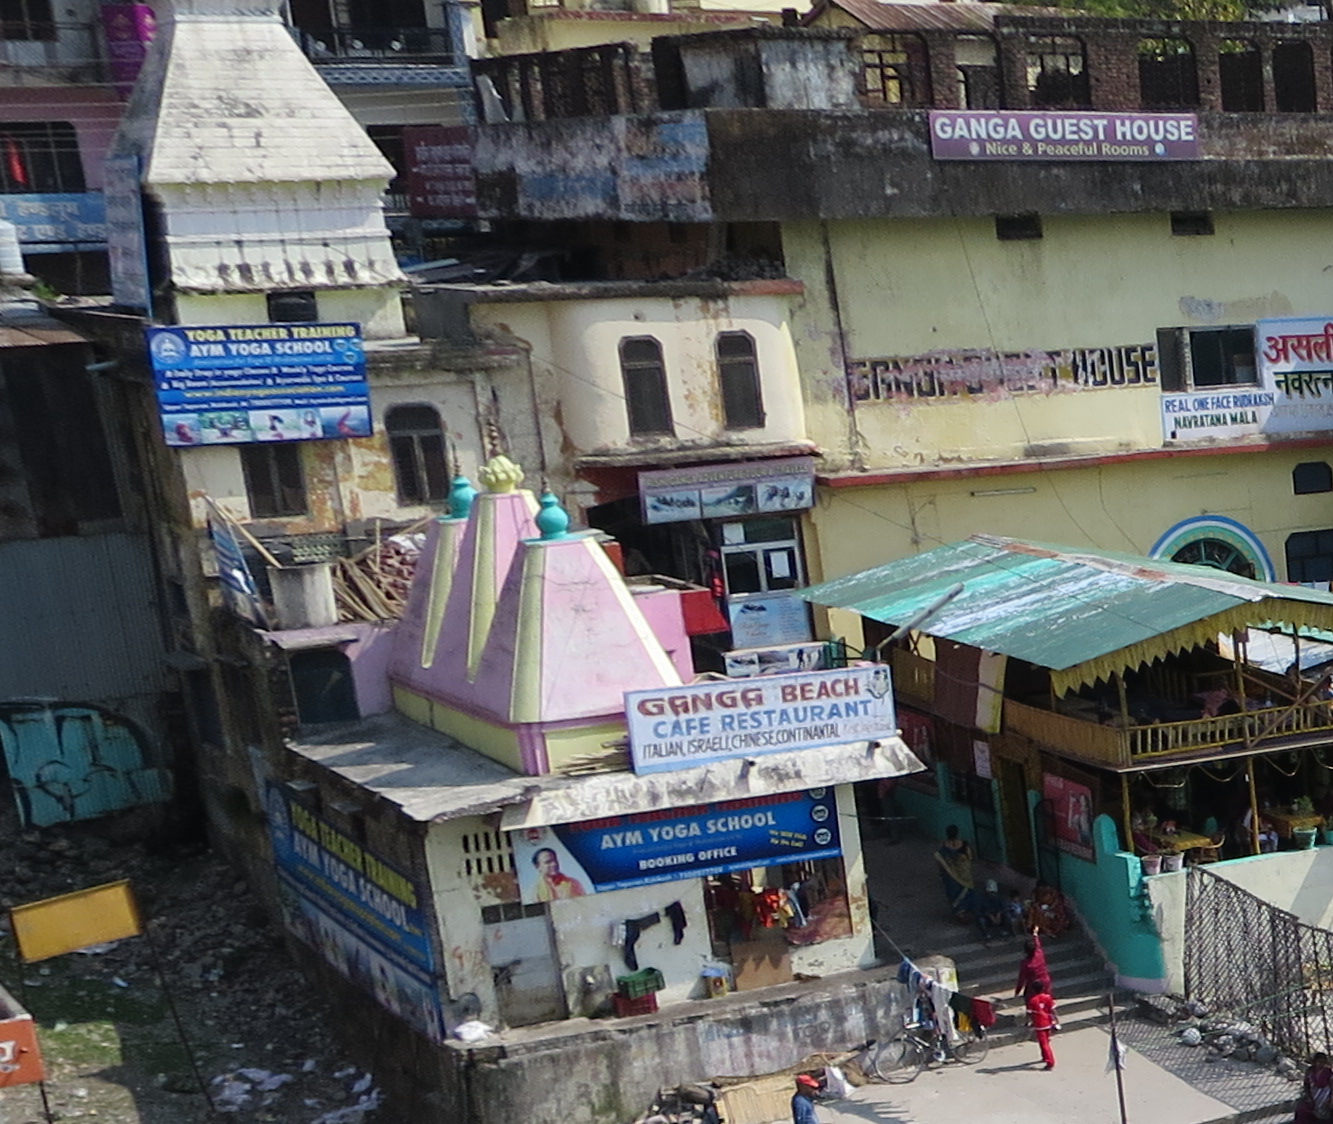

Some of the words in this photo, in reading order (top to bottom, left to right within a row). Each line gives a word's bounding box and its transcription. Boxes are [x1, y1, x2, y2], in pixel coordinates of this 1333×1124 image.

[934, 116, 1024, 141] GANGA
[1028, 117, 1109, 141] GUEST
[1114, 118, 1195, 142] HOUSE
[985, 142, 1018, 156] Nice
[1022, 142, 1034, 156] &
[1037, 142, 1098, 156] Peaceful
[1101, 142, 1149, 156] Rooms
[184, 329, 226, 342] YOGA
[230, 327, 290, 341] TEACHER
[292, 325, 356, 340] TRAINING
[189, 343, 224, 357] AYM
[230, 342, 274, 356] YOGA
[275, 340, 333, 354] SCHOOL
[1164, 398, 1192, 414] REAL
[1193, 396, 1210, 412] ONE
[1210, 395, 1232, 410] FACE
[1173, 412, 1228, 430] NAVRATANA
[1230, 409, 1258, 426] MALA
[636, 686, 765, 718] GANGA
[779, 677, 860, 704] BEACH
[652, 716, 711, 739] CAFE
[720, 699, 872, 733] RESTAURANT
[601, 830, 644, 850] AYM
[648, 823, 702, 843] YOGA
[706, 811, 777, 834] SCHOOL
[318, 820, 364, 874] TEACHER
[364, 850, 417, 910] TRAINING
[638, 851, 695, 871] BOOKING
[697, 845, 738, 862] OFFICE
[322, 851, 358, 895] YOGA
[358, 876, 410, 934] SCHOOL
